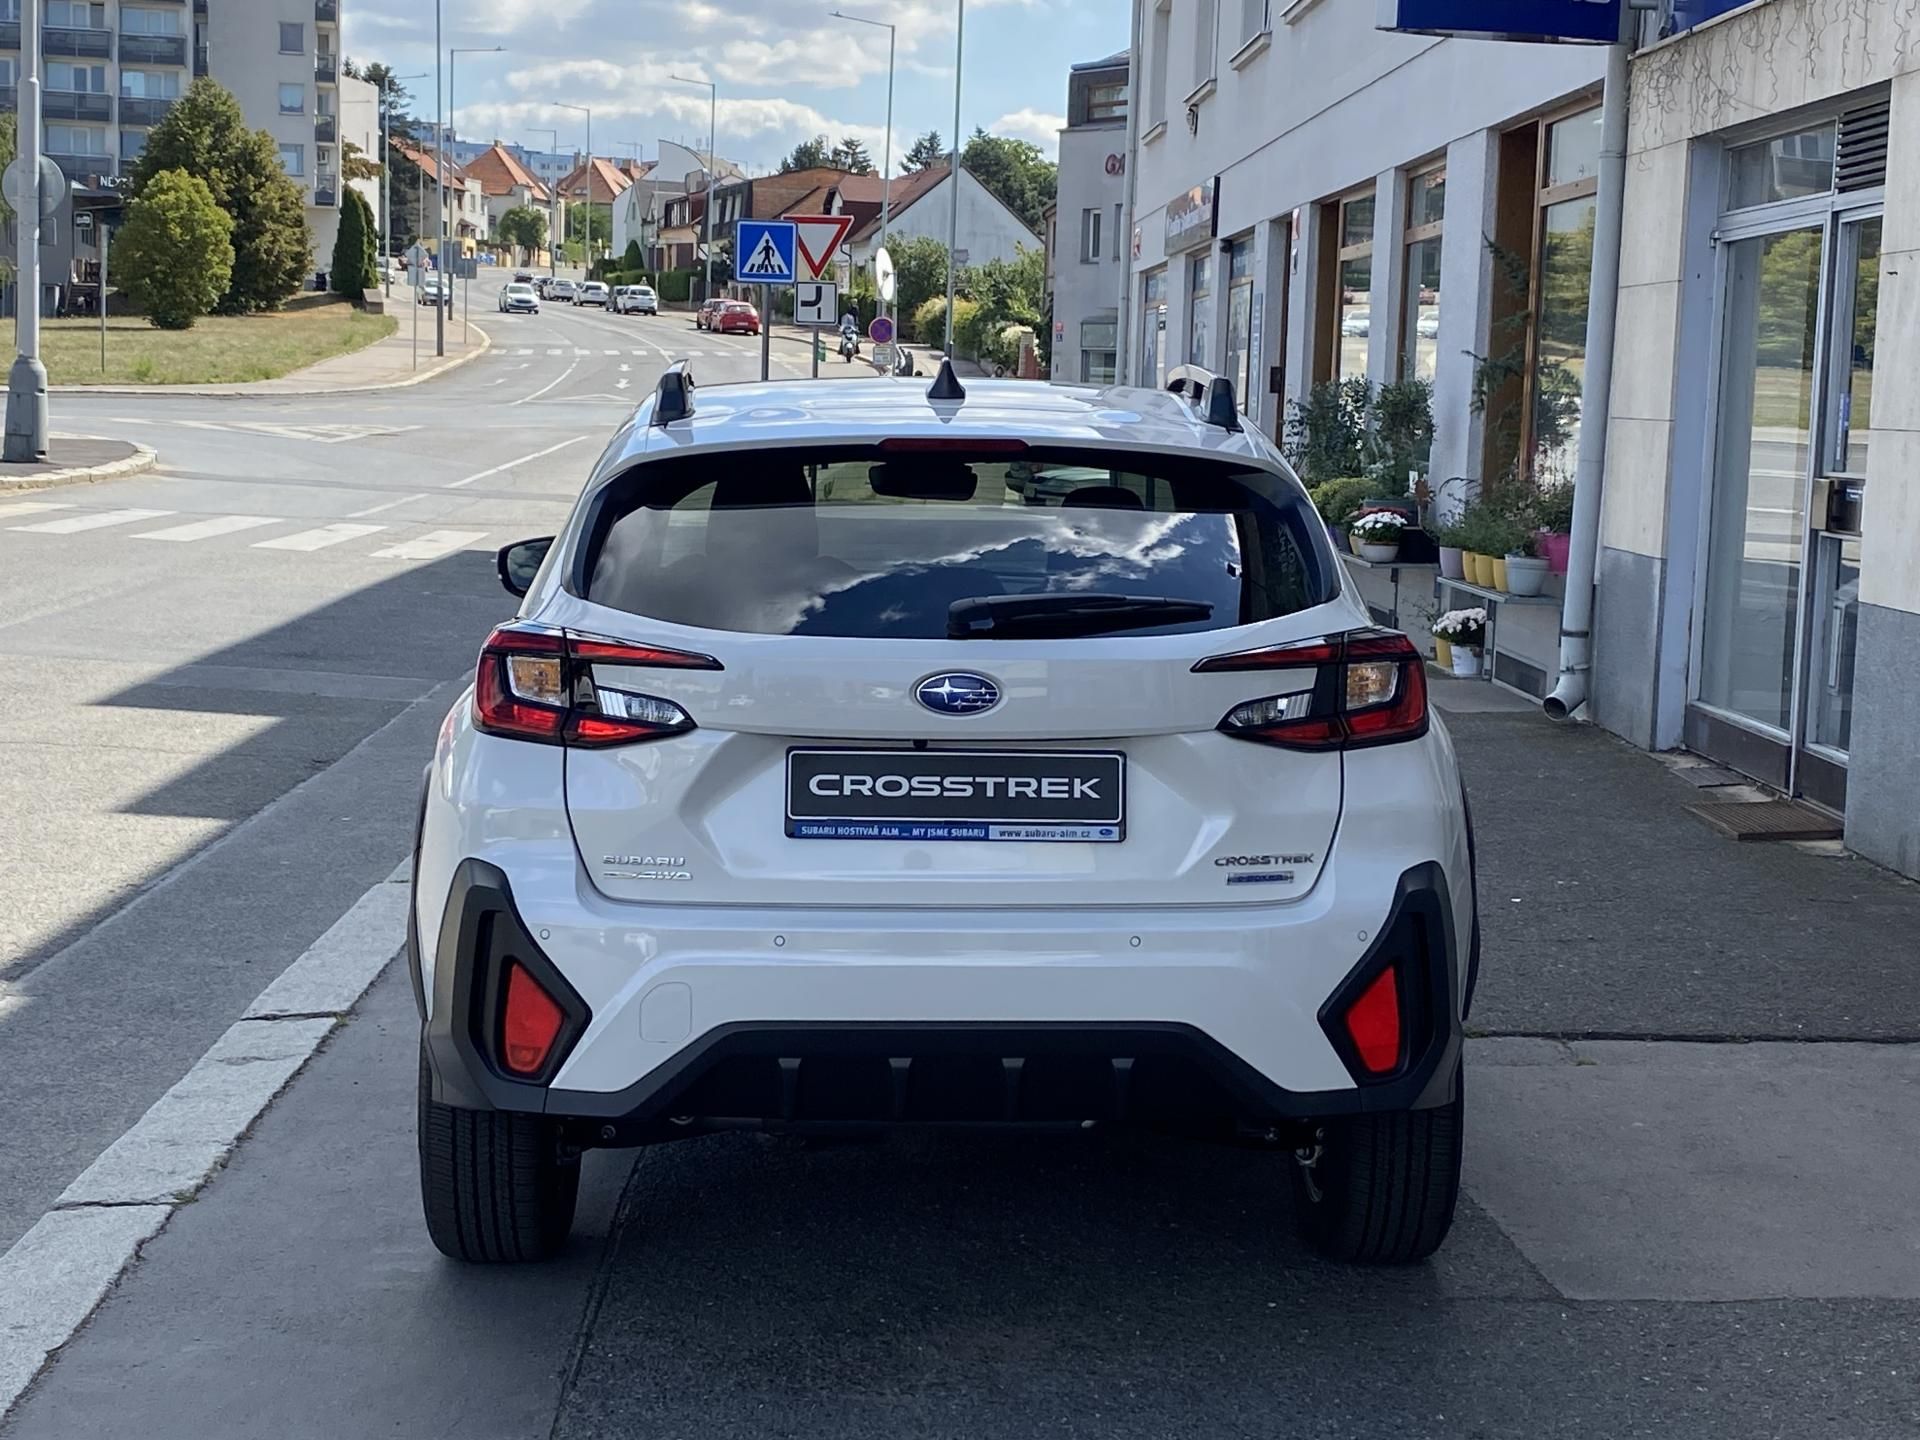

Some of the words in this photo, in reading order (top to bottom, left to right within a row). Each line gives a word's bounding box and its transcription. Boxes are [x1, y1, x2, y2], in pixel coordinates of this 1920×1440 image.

[808, 774, 1101, 799] CROSSTREK
[801, 825, 835, 835] SUBARU
[837, 825, 879, 836] HOSTIVAŘ
[881, 827, 899, 836] ALM
[912, 828, 925, 836] MY
[927, 828, 949, 838] JSME
[951, 828, 985, 837] SUBARU
[602, 855, 685, 866] SUBARU
[1214, 853, 1314, 867] CROSSTREK
